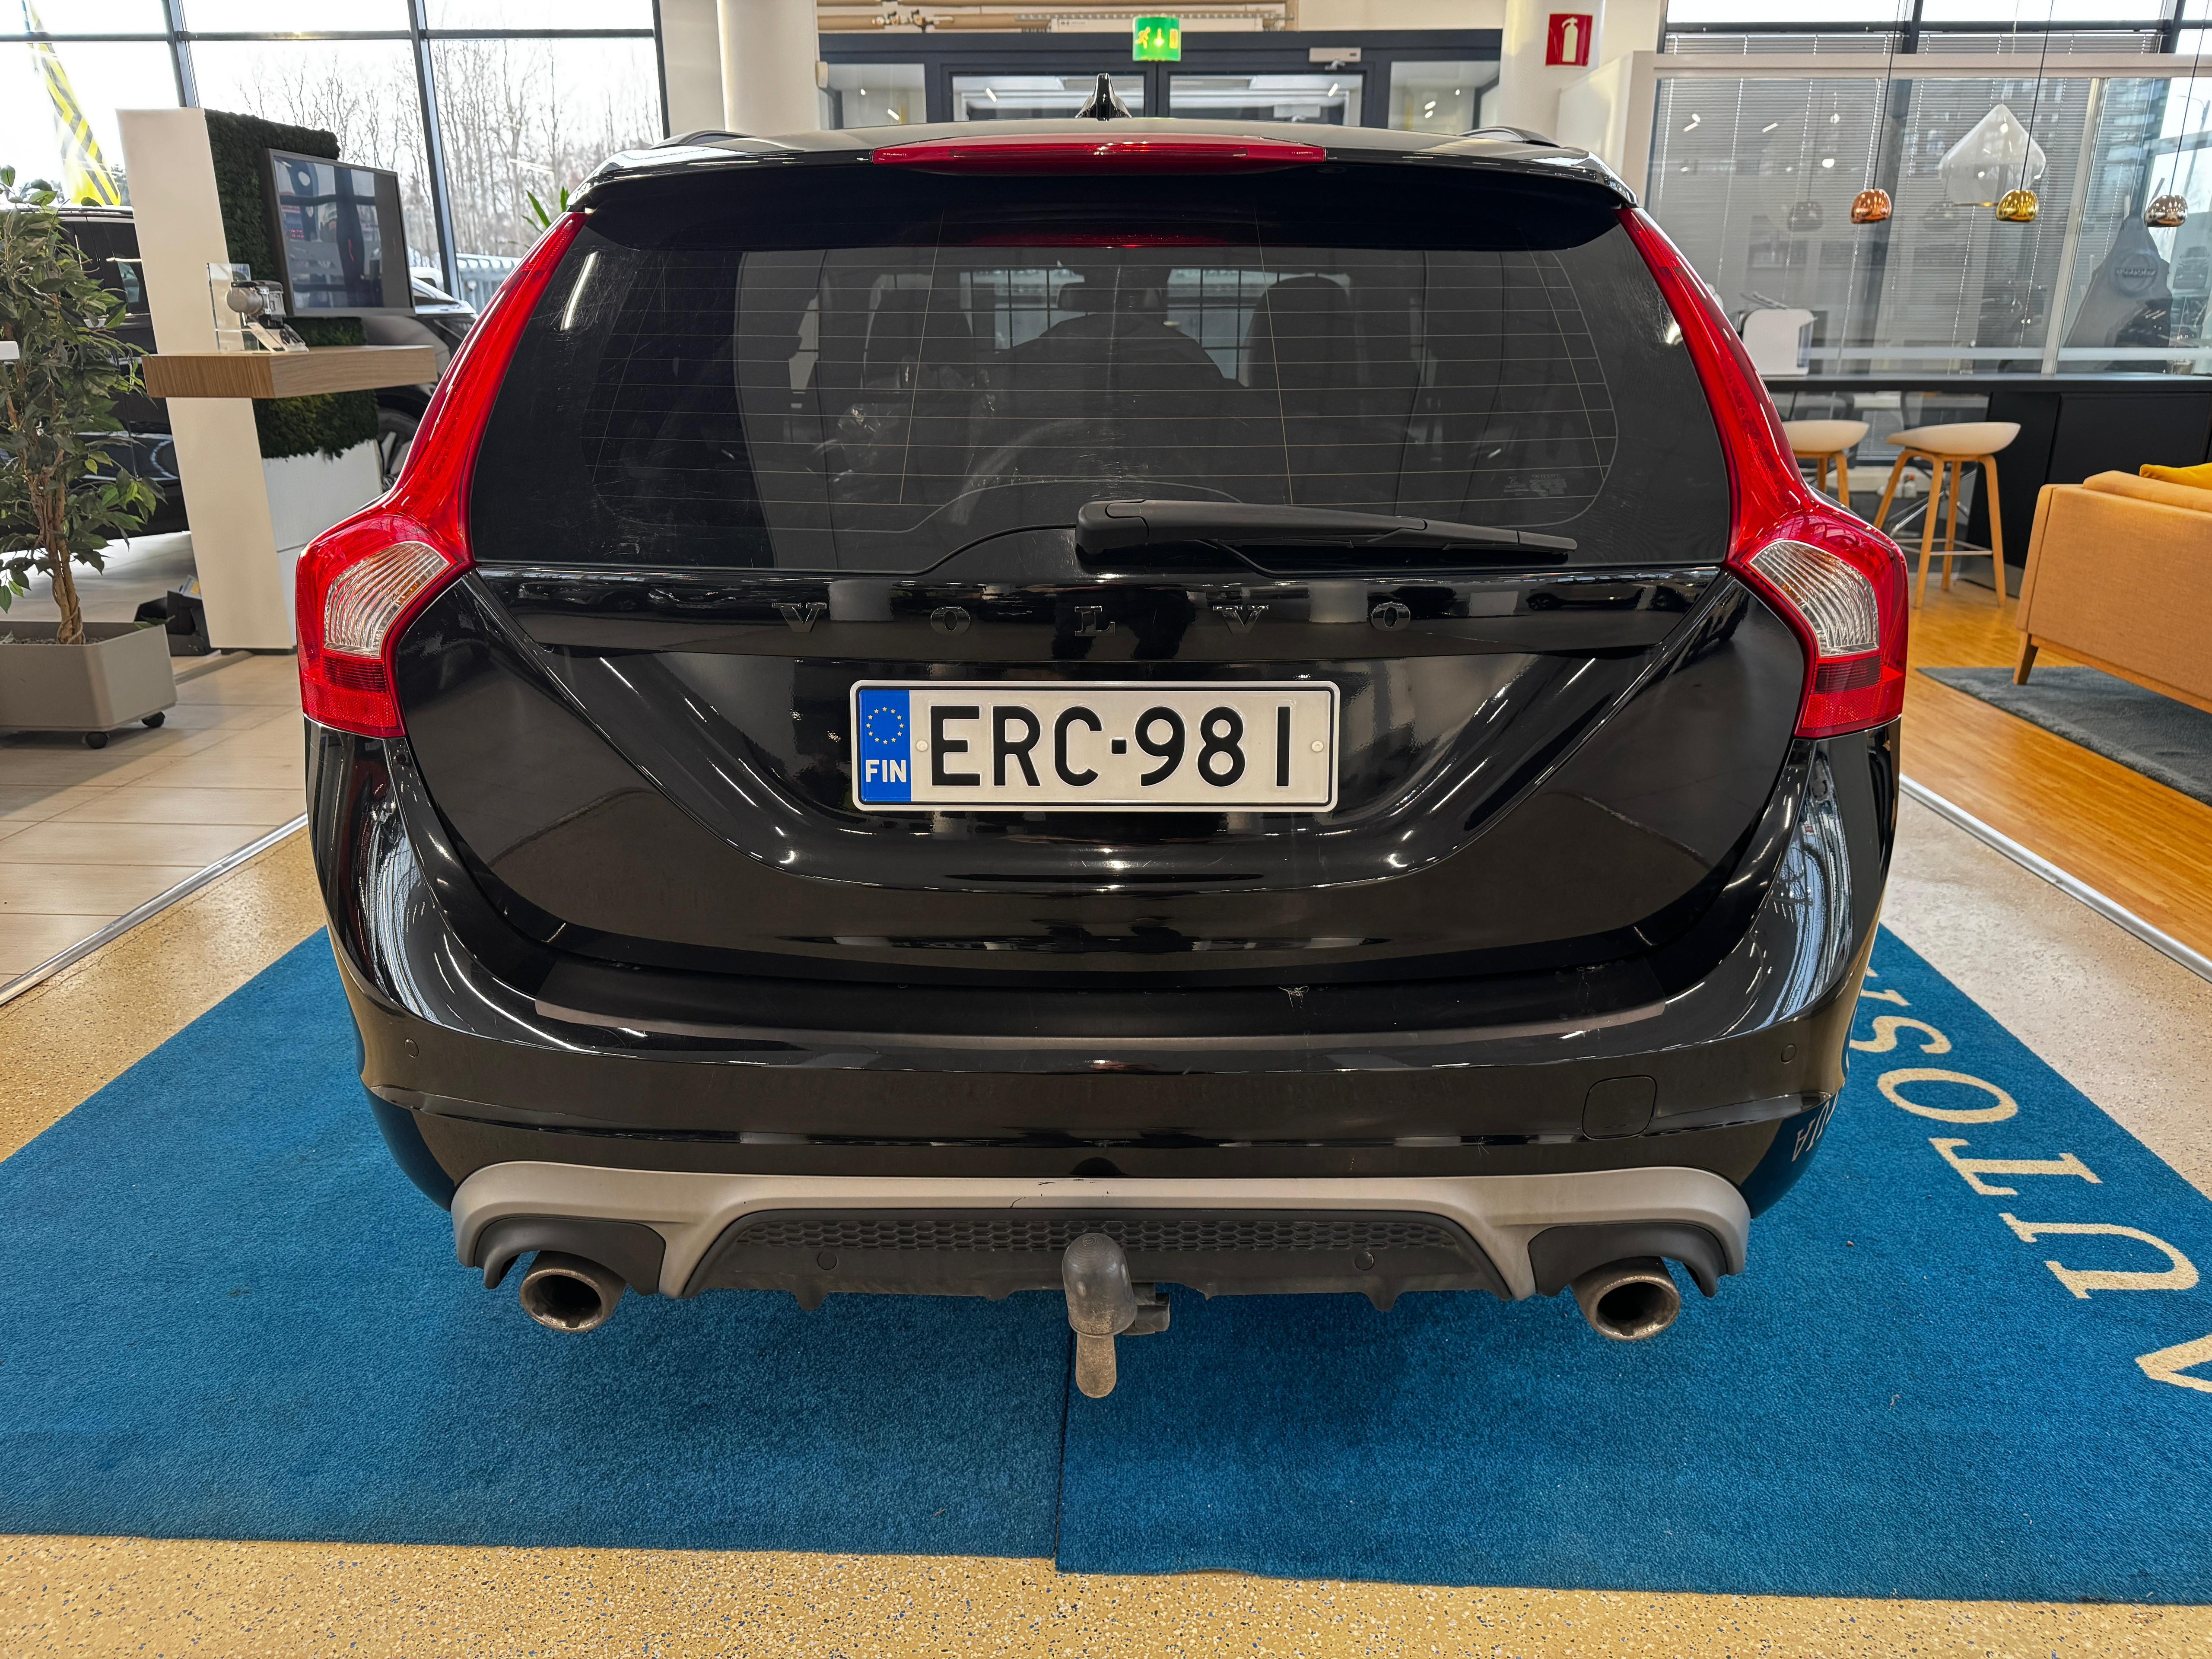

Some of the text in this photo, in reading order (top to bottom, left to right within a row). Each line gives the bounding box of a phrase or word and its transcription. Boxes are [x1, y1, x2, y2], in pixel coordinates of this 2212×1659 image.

[772, 601, 1411, 636] VOLVO
[931, 706, 1290, 787] ERC-981
[865, 760, 906, 782] FIN
